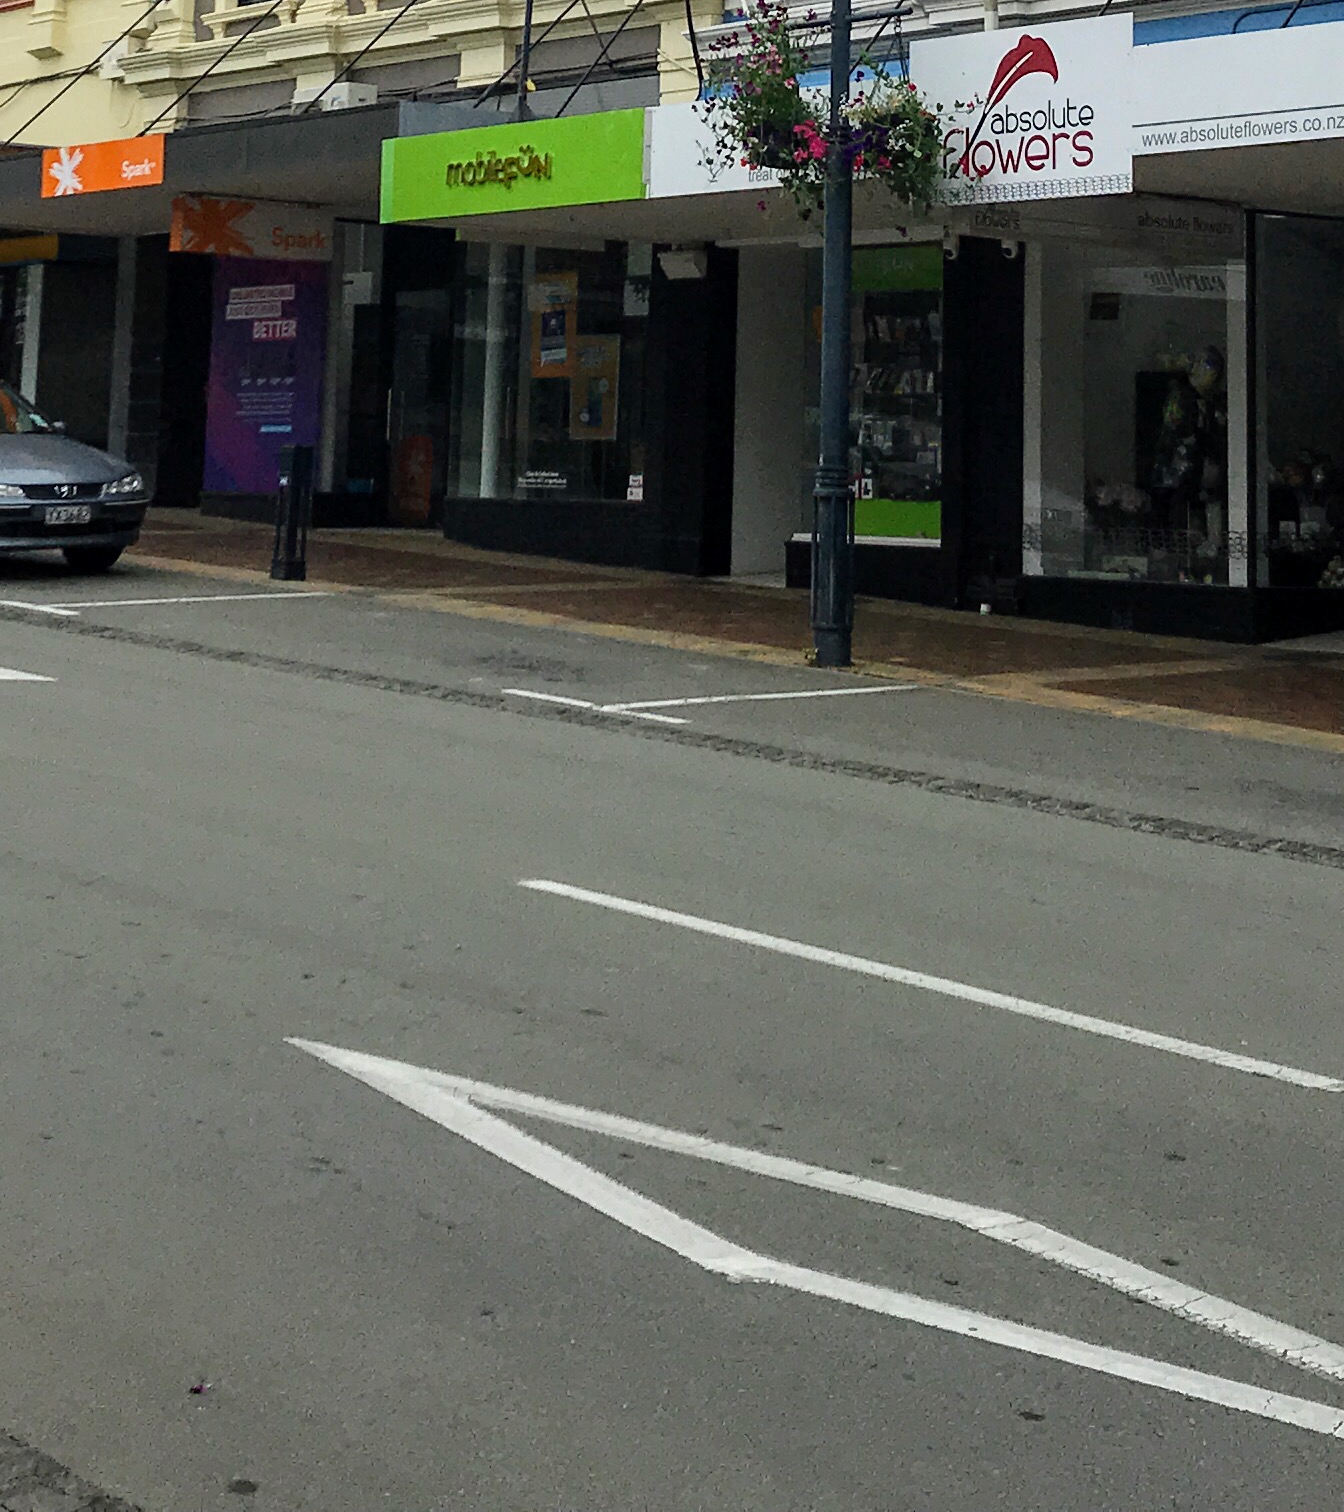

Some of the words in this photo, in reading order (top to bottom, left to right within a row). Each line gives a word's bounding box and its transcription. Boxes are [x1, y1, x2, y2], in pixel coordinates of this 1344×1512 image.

[990, 98, 1094, 135] absolute
[120, 157, 153, 181] Spark
[1136, 213, 1191, 231] absolute
[271, 226, 326, 252] Spark
[254, 320, 297, 338] BETTER
